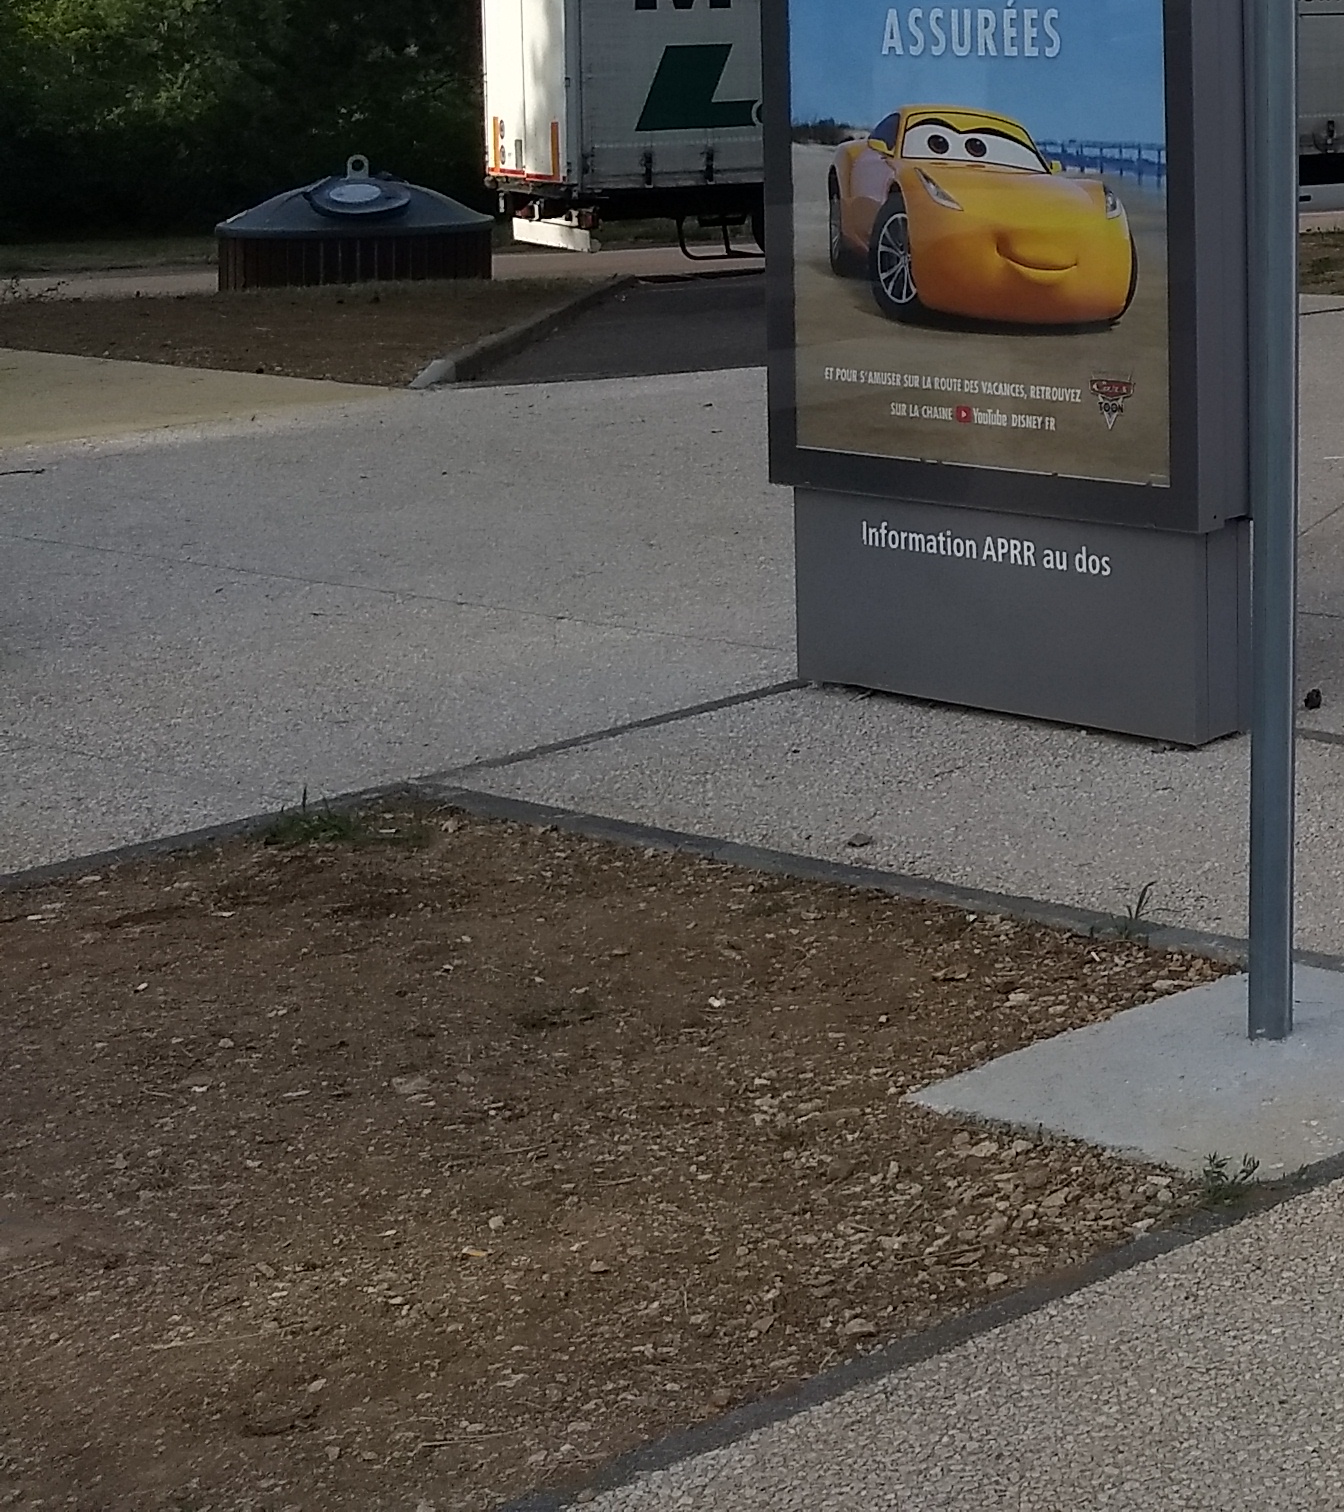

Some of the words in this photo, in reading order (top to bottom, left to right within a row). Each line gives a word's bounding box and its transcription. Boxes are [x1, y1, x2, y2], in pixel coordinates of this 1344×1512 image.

[824, 367, 834, 380] ET
[836, 368, 858, 382] POUR
[903, 374, 920, 388] SUR
[922, 376, 932, 389] LA
[934, 377, 962, 392] ROUTE
[964, 379, 979, 393] DES
[981, 381, 1028, 399] VACANCES,
[1030, 385, 1081, 402] RETROUVEZ
[890, 402, 907, 417] SUR
[909, 404, 919, 417] LA
[973, 408, 1007, 426] YouTube
[1011, 414, 1042, 429] DISNEY
[1045, 417, 1056, 431] FR
[1098, 401, 1124, 413] TOON
[861, 520, 977, 560] Information
[982, 535, 1037, 568] APRR
[1042, 547, 1068, 572] au
[1075, 546, 1112, 577] dos
